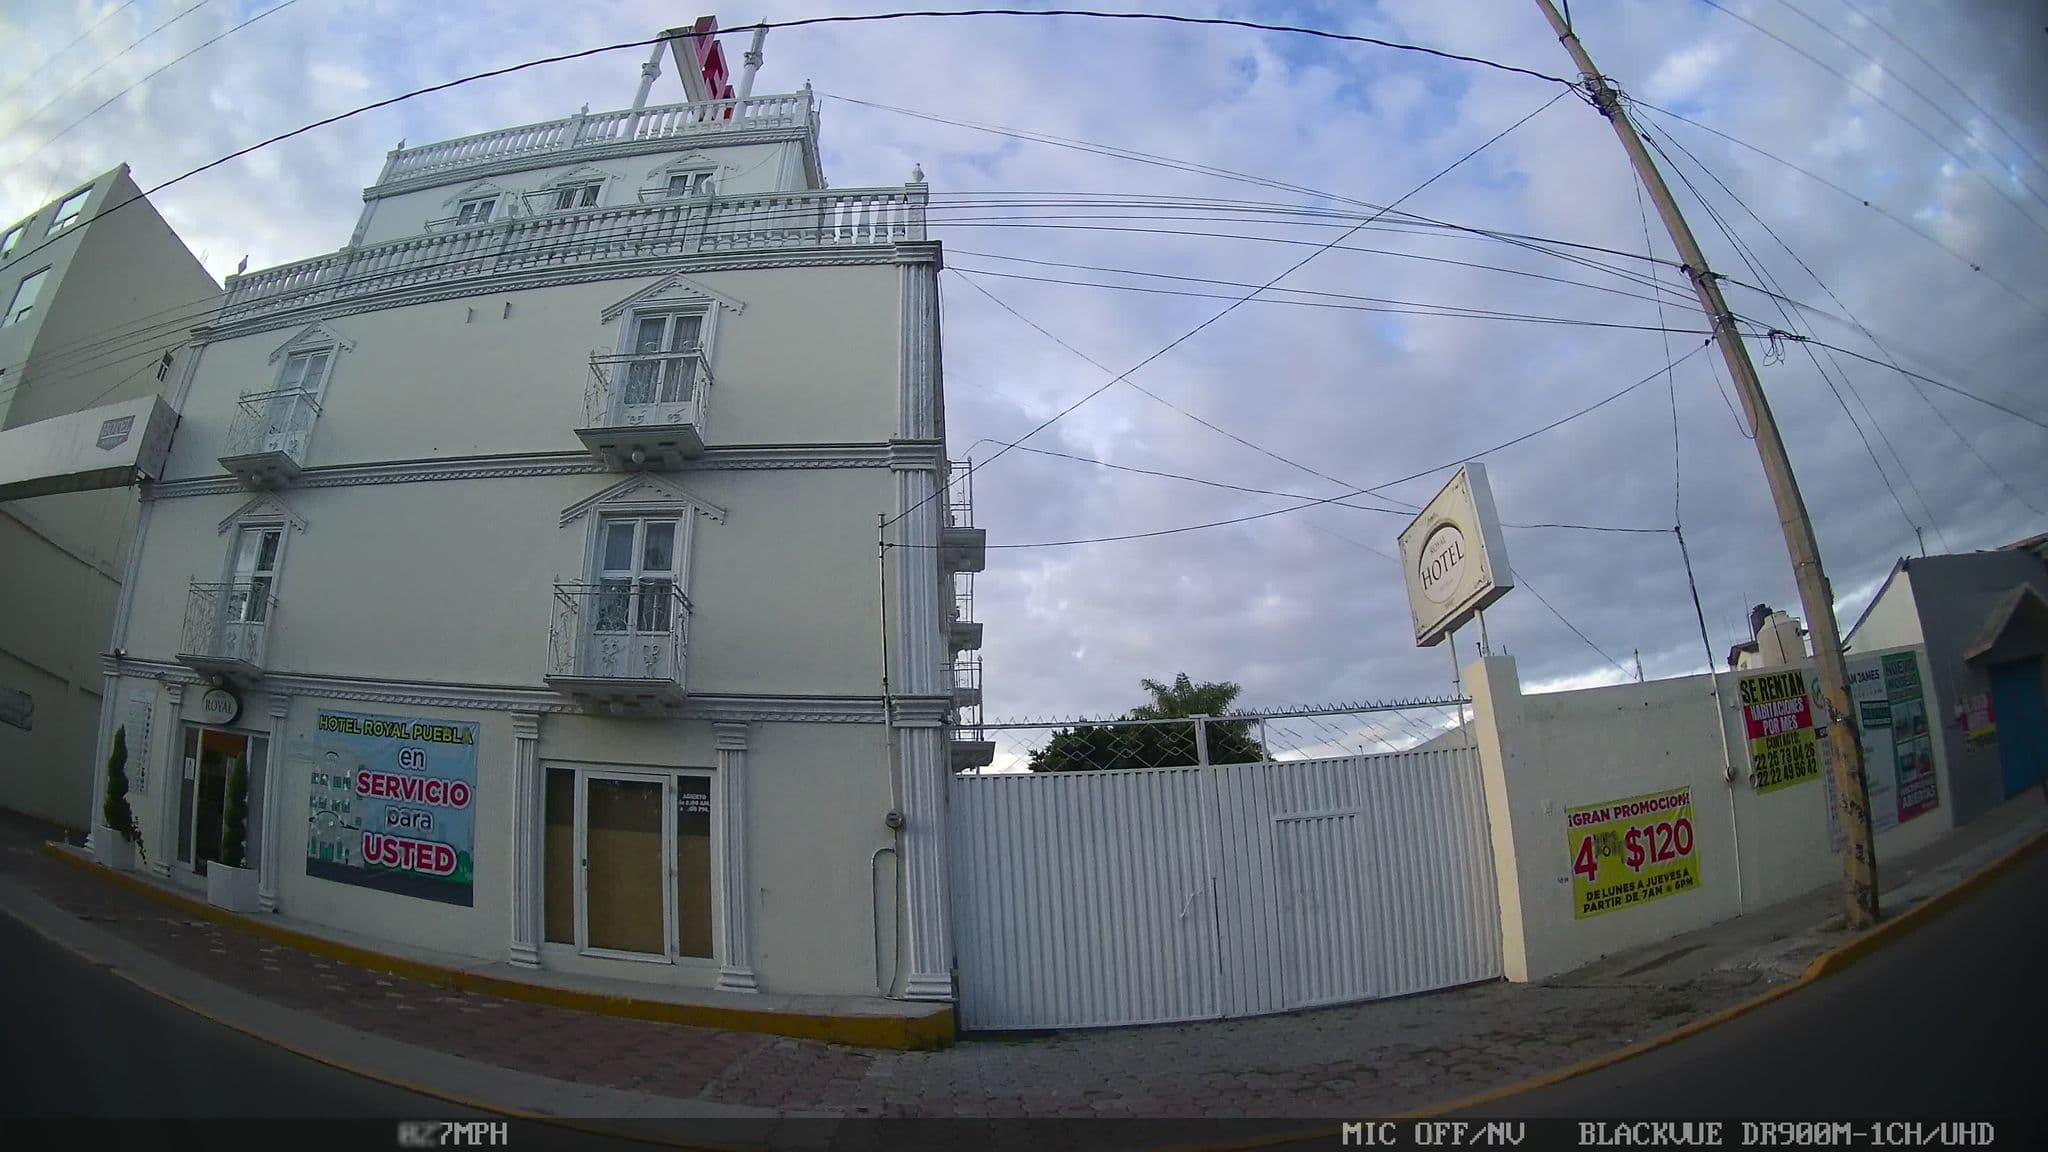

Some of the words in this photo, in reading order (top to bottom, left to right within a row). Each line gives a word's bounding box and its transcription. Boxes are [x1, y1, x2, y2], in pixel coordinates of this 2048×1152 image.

[1422, 541, 1464, 590] HOTEL
[1740, 679, 1757, 703] SE
[1760, 672, 1805, 702] RENTAN
[1857, 669, 1880, 684] JAMES
[205, 699, 232, 714] ROYAL
[1750, 697, 1804, 720] HABITACIONES
[319, 715, 360, 734] HOTEL
[364, 720, 409, 739] ROYAL
[413, 725, 473, 745] PUEBLA
[1763, 718, 1780, 735] POR
[1781, 715, 1798, 732] MES
[400, 748, 425, 769] en
[1755, 754, 1767, 770] 22
[1768, 750, 1779, 768] 25
[1780, 747, 1791, 764] 73
[1805, 742, 1815, 757] 26
[357, 771, 470, 808] SERVICIO
[1757, 770, 1769, 787] 22
[1770, 767, 1782, 784] 22
[386, 806, 433, 831] para
[1568, 807, 1610, 827] ¡GRAN
[363, 833, 456, 875] USTED
[1574, 836, 1598, 881] 4
[1625, 818, 1694, 872] $120
[1583, 897, 1622, 913] PARTIR
[1625, 892, 1639, 903] DE
[1642, 884, 1663, 899] 7AM
[1675, 877, 1693, 890] 6PM
[1586, 890, 1600, 901] DE
[1602, 882, 1635, 897] LUNES
[1637, 880, 1644, 889] A
[1646, 870, 1681, 887] JUEVES
[1682, 867, 1690, 877] A
